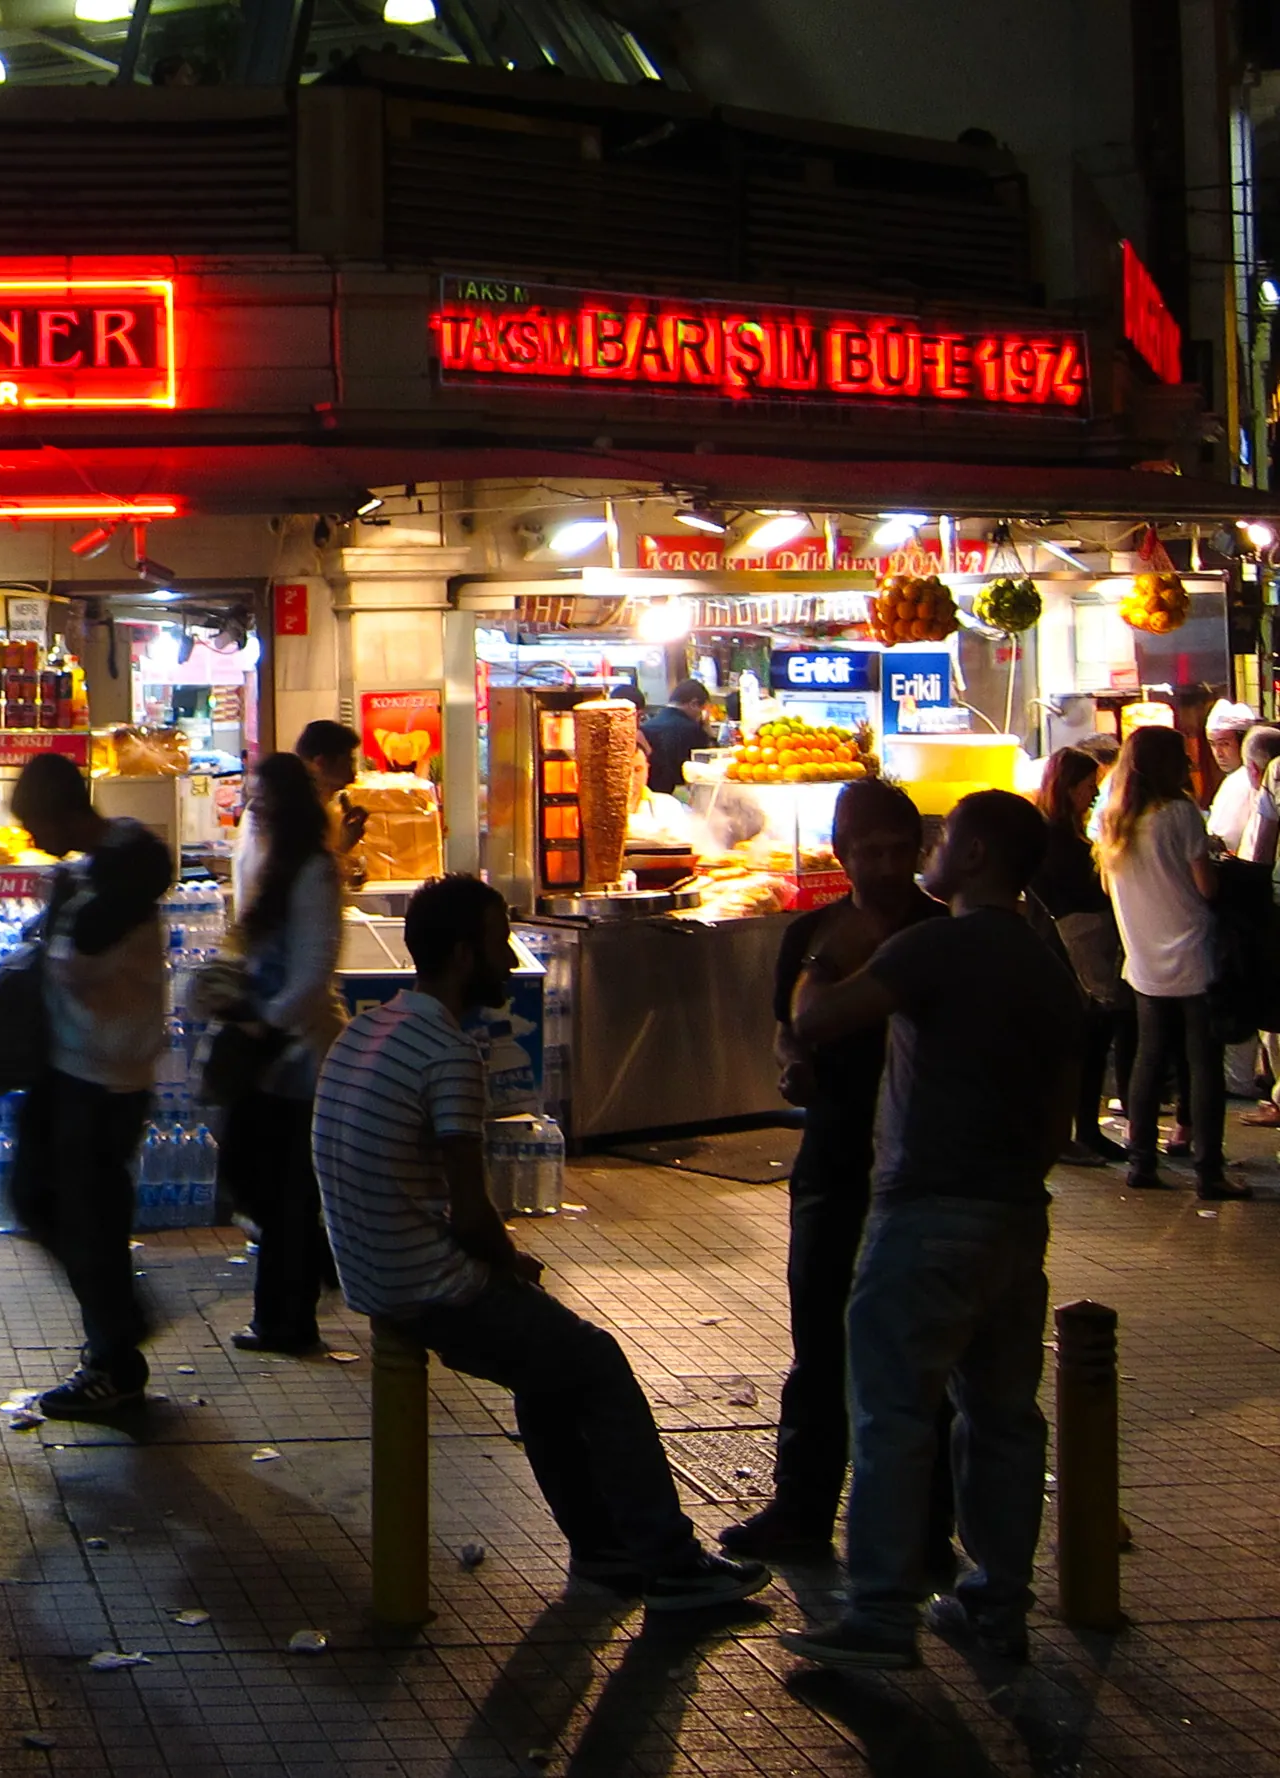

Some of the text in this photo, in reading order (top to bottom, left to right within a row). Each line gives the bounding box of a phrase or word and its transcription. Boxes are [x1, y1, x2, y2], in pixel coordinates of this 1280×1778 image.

[976, 336, 1085, 405] 1974
[787, 656, 851, 684] Erikli
[891, 673, 941, 702] Erikli
